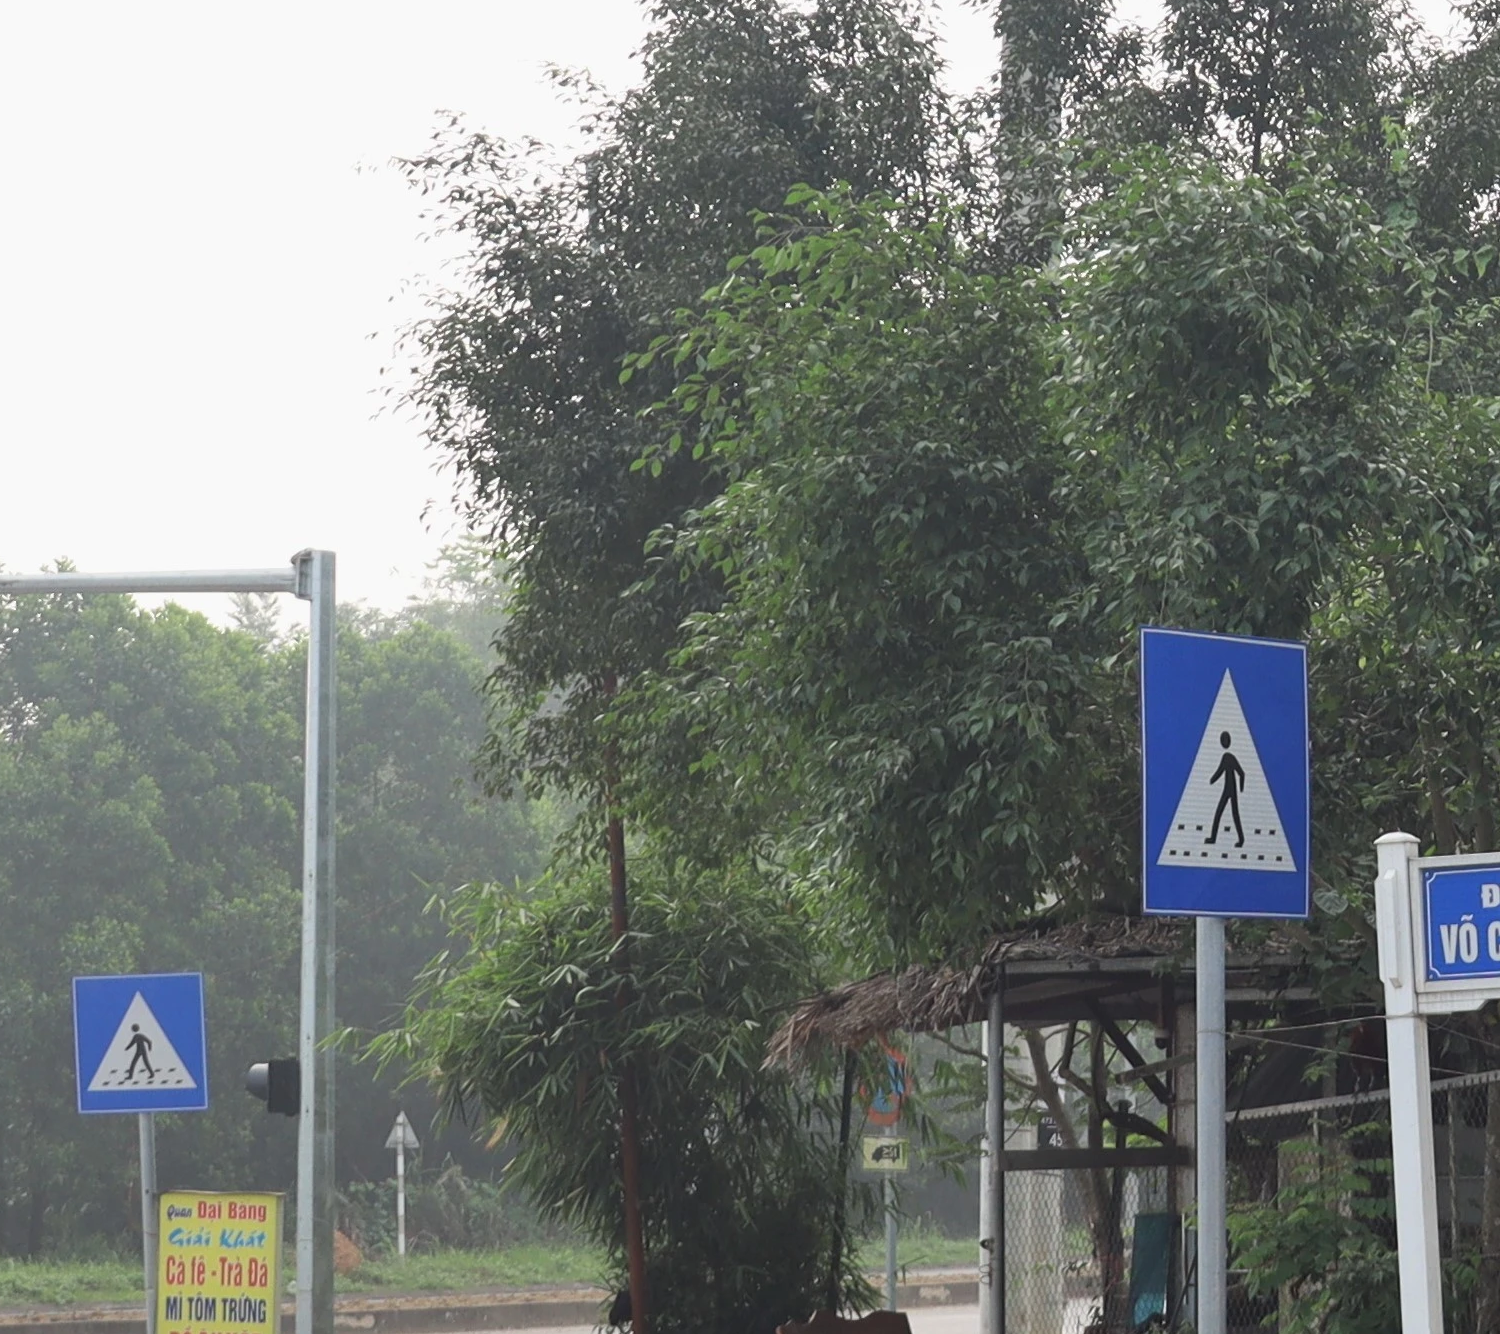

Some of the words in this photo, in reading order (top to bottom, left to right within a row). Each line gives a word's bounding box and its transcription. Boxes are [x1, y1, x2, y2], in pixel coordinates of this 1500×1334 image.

[1439, 914, 1479, 965] VÕ
[248, 1256, 268, 1287] Đá
[187, 1291, 216, 1322] TÔM
[222, 1292, 267, 1323] TRỨNG
